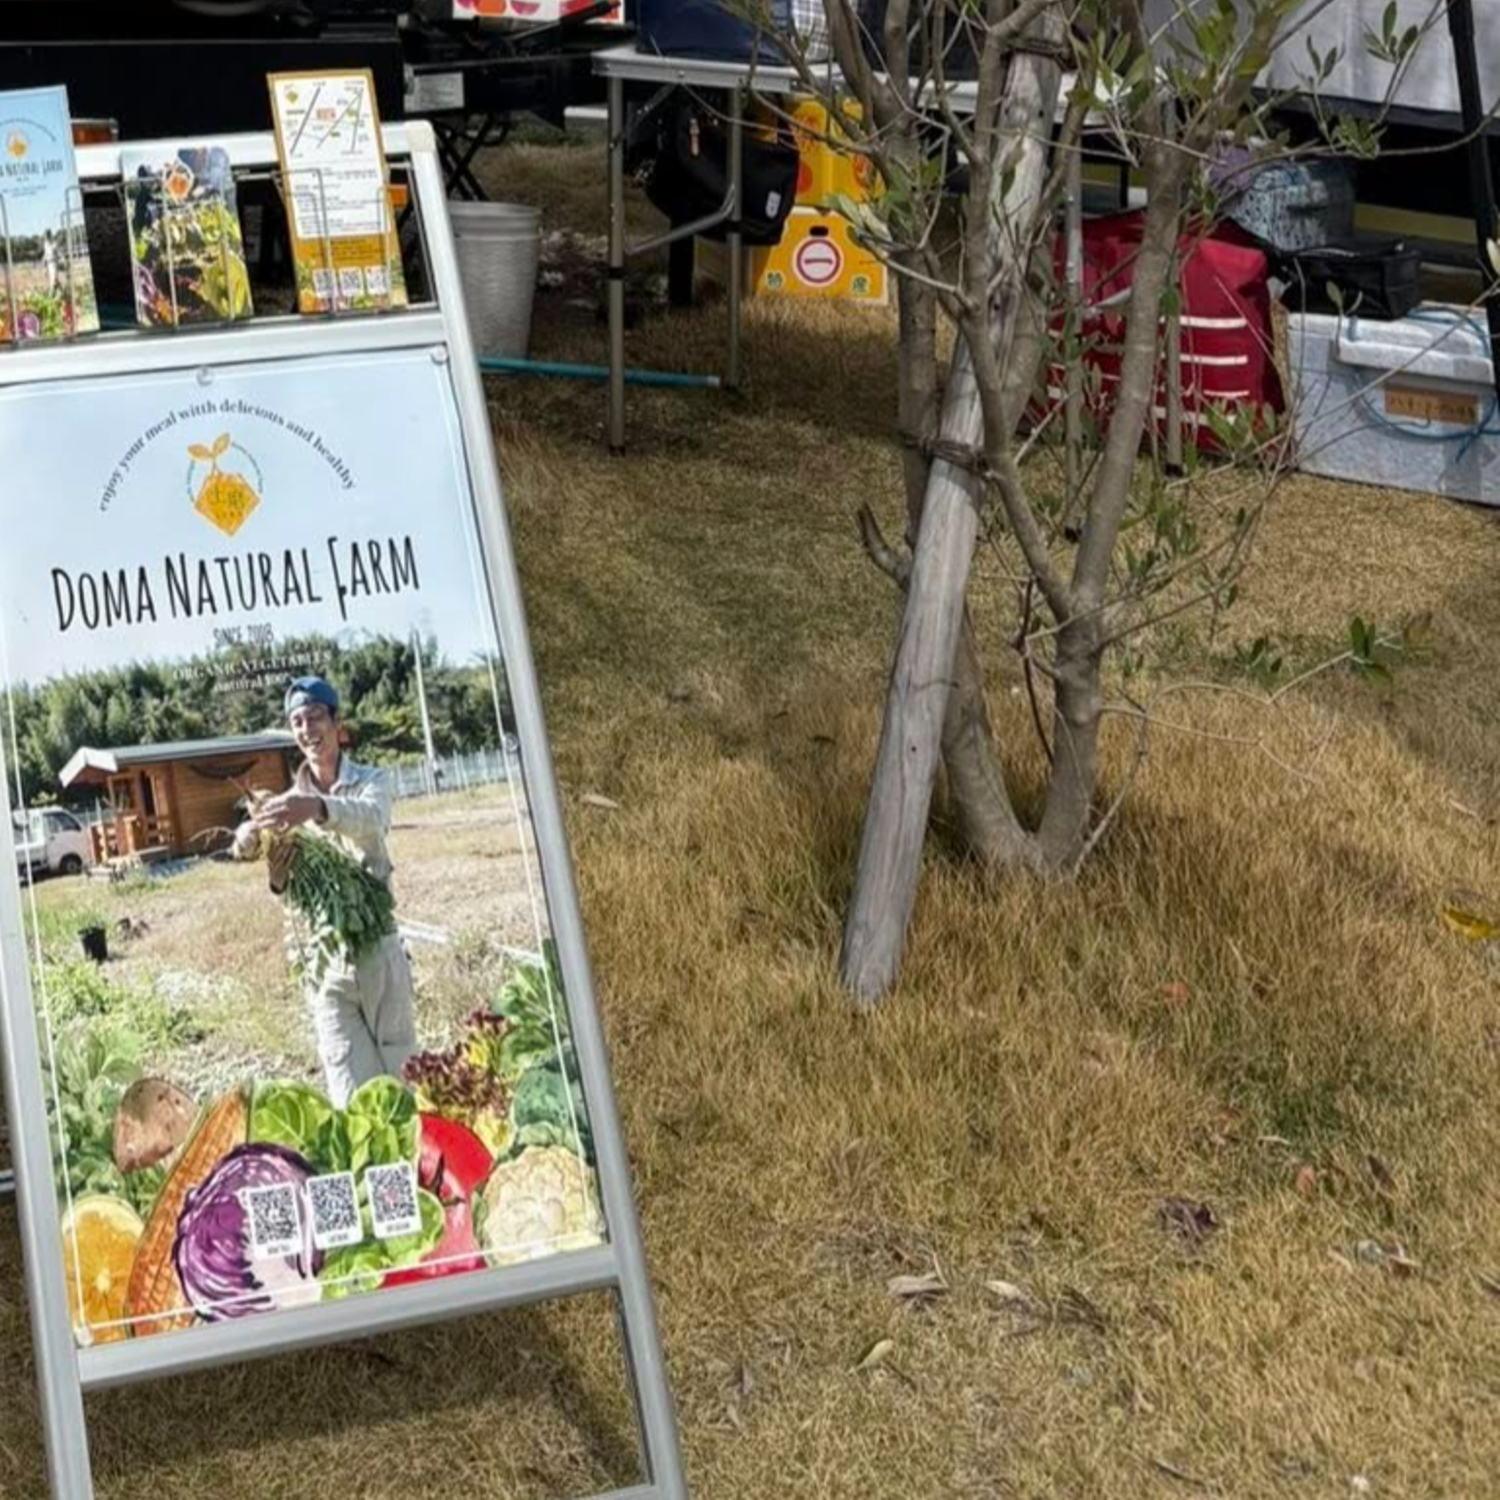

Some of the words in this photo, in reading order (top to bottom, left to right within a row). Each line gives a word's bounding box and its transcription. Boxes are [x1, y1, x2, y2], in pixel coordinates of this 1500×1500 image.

[100, 467, 124, 512] enjoy
[119, 437, 145, 473] your
[145, 410, 177, 441] meal
[219, 399, 285, 426] delicious
[286, 421, 315, 443] and
[313, 436, 356, 490] healthy
